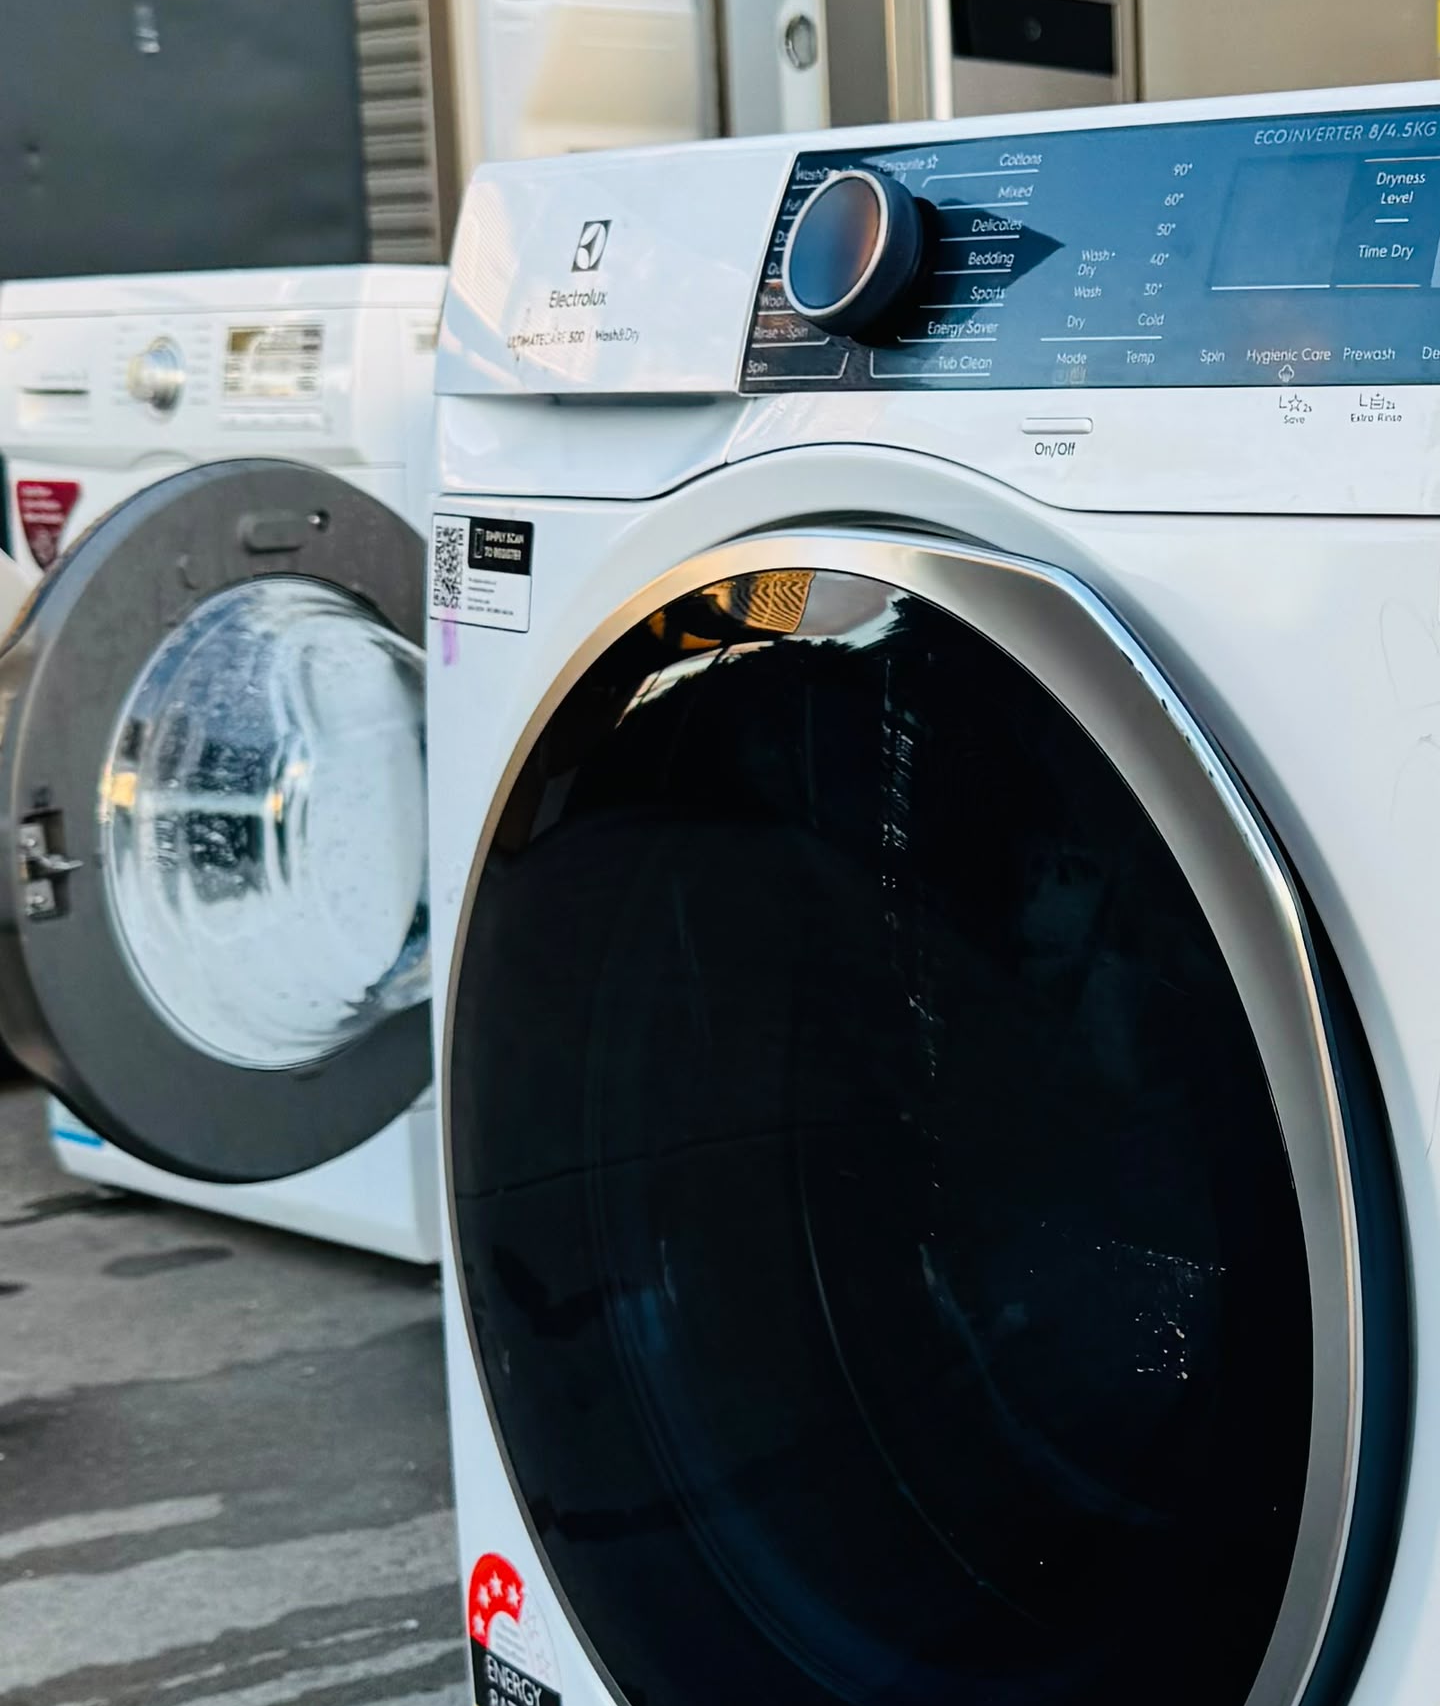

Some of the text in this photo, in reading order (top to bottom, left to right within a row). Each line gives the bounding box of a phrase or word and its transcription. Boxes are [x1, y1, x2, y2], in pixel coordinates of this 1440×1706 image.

[1253, 125, 1363, 145] ECOINVERTER
[1367, 121, 1437, 141] 8/4.5KG
[999, 152, 1043, 167] Cottons
[1375, 171, 1427, 189] Dryness
[997, 184, 1034, 199] Mixed
[1380, 191, 1414, 205] Level
[970, 218, 1024, 233] Delicates
[967, 251, 1015, 268] Bedding
[1358, 244, 1415, 261] Time Dry
[1077, 263, 1097, 279] Dry
[548, 288, 608, 309] Electrolux
[969, 285, 1007, 302] Sports
[1073, 285, 1102, 298] Wash
[1066, 315, 1086, 330] Dry
[1137, 312, 1166, 327] Cold
[926, 319, 999, 338] Energy Saver
[1055, 351, 1088, 365] Mode
[1125, 350, 1156, 367] Temp
[1199, 348, 1226, 364] Spin
[1246, 347, 1332, 365] Hygienic Care
[1342, 346, 1396, 362] Prewash
[746, 357, 768, 374] Spin
[937, 355, 993, 370] Tub Clean
[1034, 441, 1076, 458] On/Off
